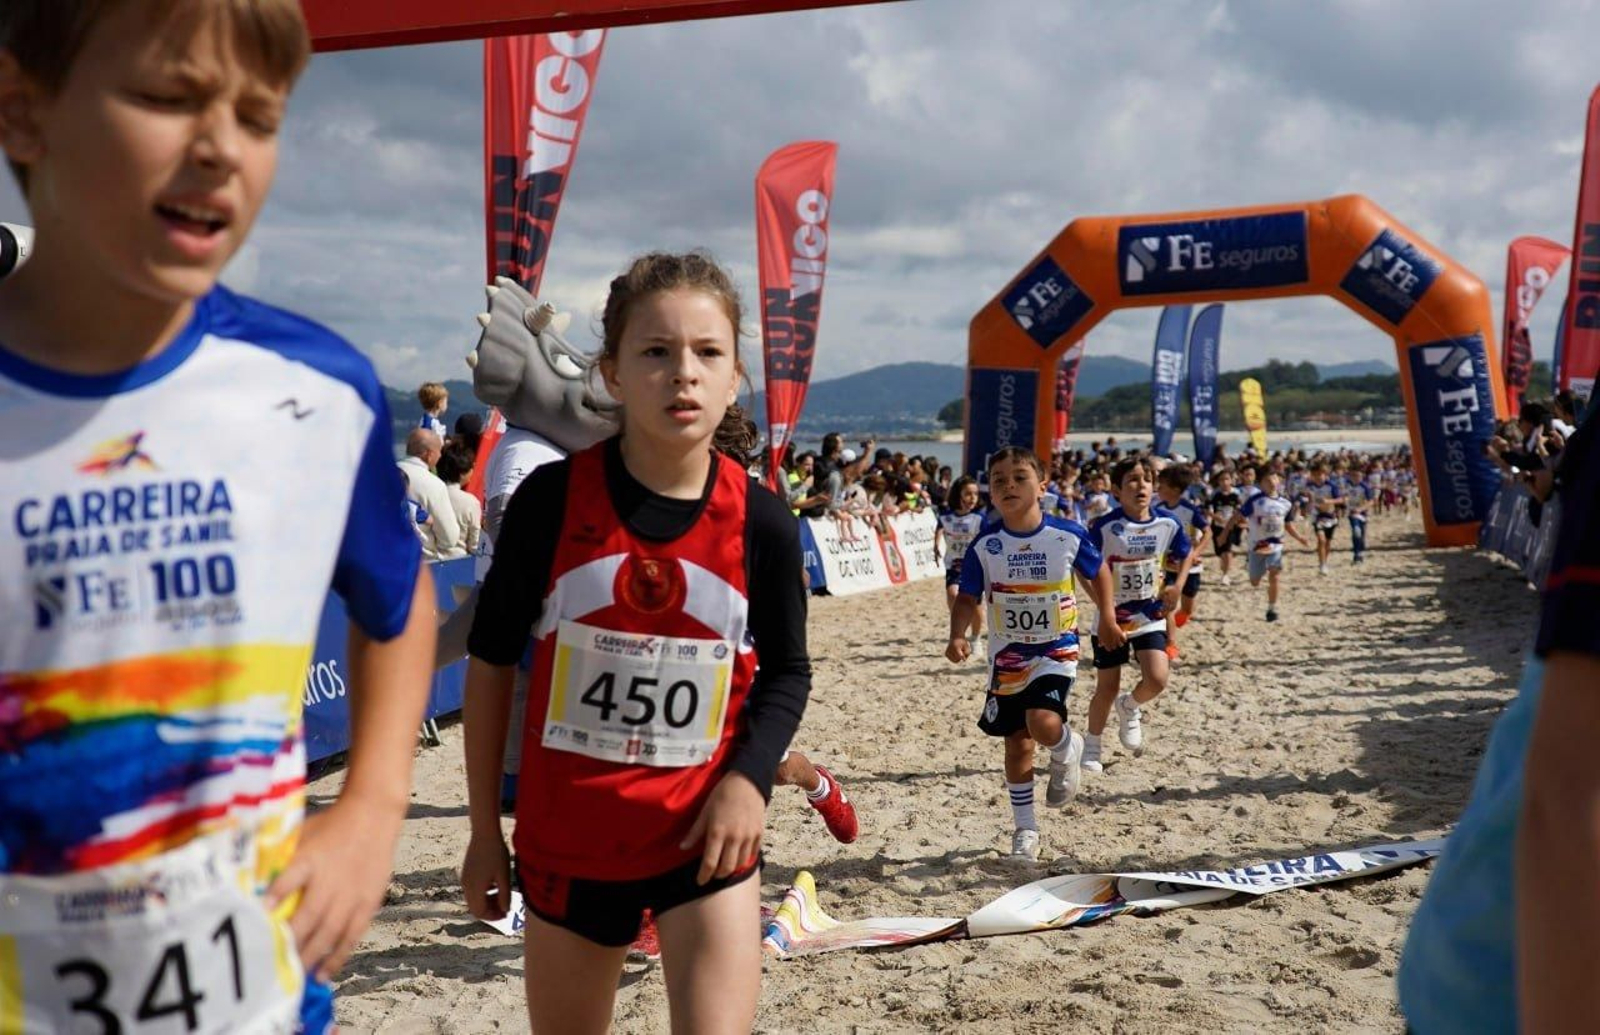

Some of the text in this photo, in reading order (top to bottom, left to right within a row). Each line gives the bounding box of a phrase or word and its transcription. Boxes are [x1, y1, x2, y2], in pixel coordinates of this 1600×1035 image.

[1219, 244, 1299, 271] seguros
[765, 287, 794, 380] RUN
[996, 374, 1018, 450] seguros
[1445, 440, 1474, 519] seguros
[15, 479, 233, 539] CARREIRA
[26, 533, 112, 568] PRAIA
[121, 529, 150, 552] DE
[1007, 553, 1047, 561] CARREIRA
[150, 554, 237, 603] 100
[1030, 566, 1047, 576] 100
[1121, 571, 1153, 591] 334
[1005, 609, 1050, 630] 304
[677, 644, 698, 656] 100
[580, 671, 699, 729] 450
[54, 913, 244, 1035] 341
